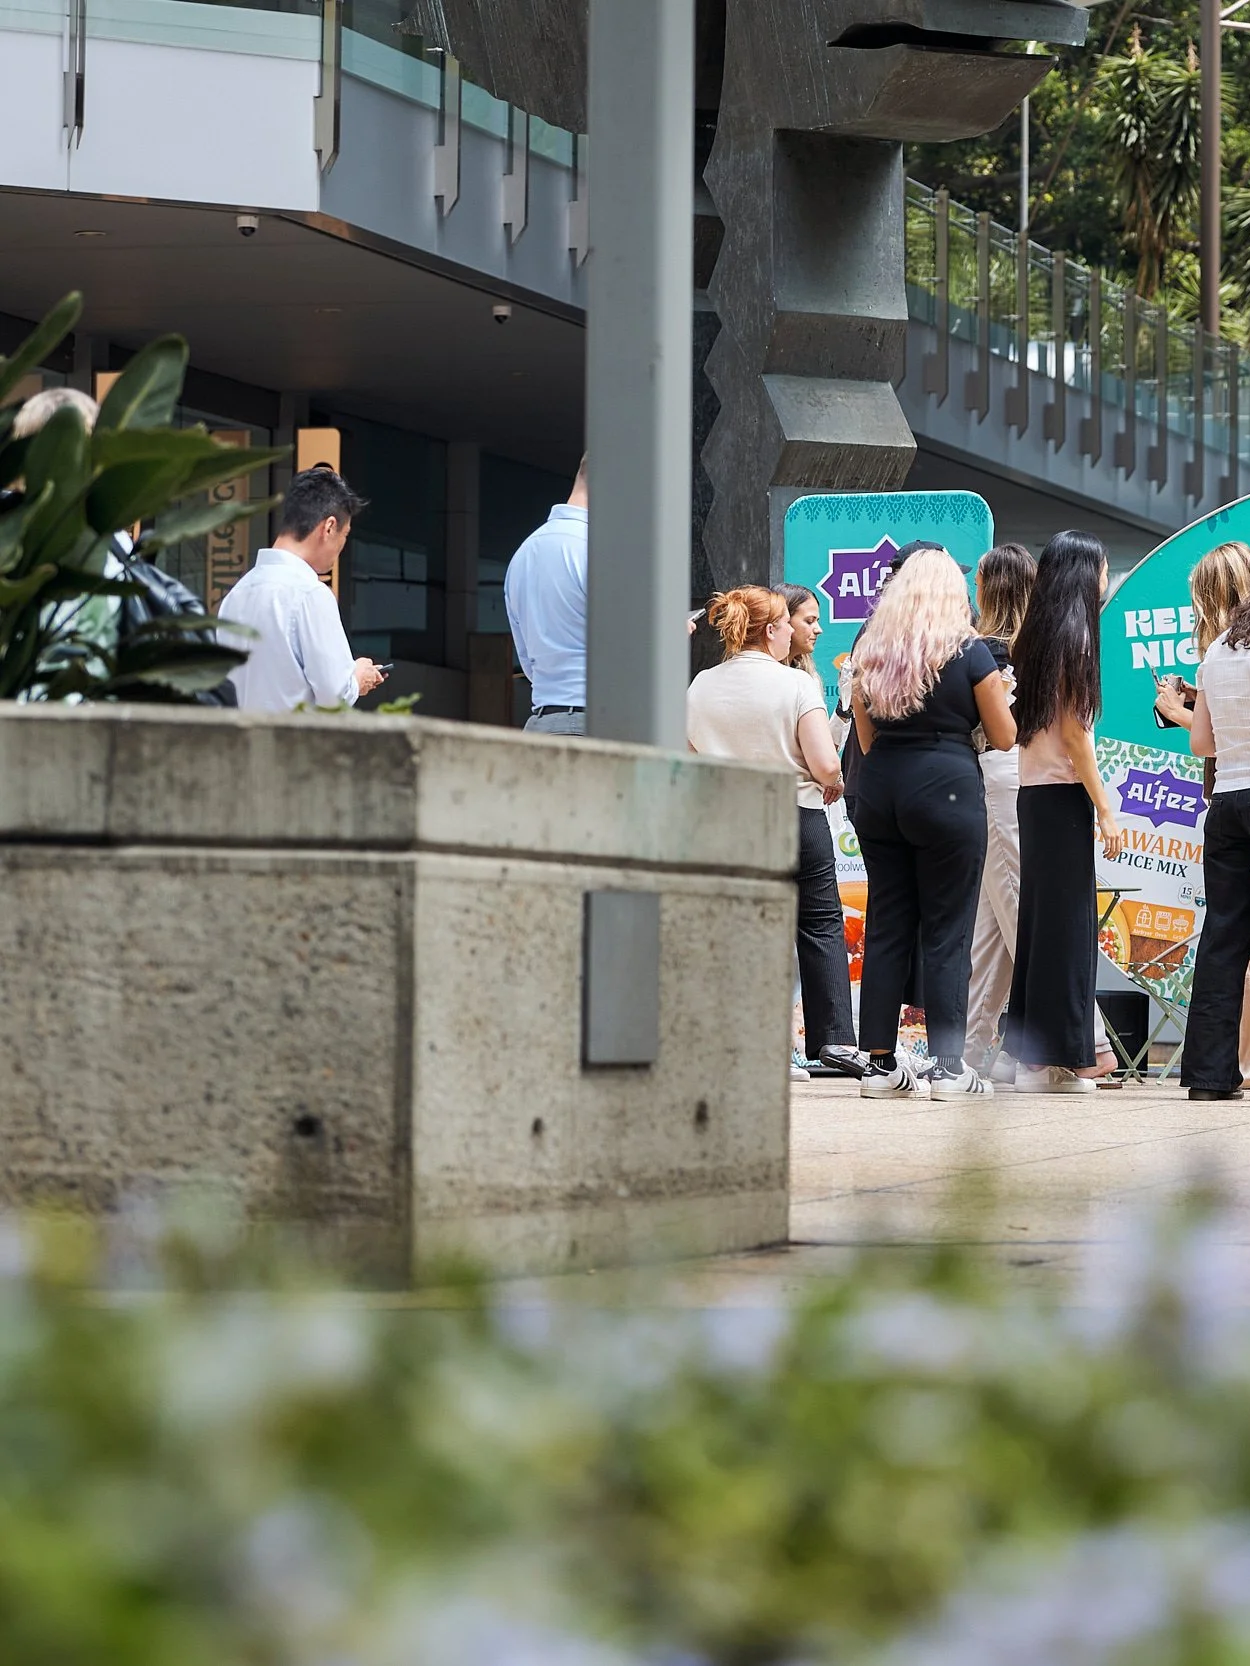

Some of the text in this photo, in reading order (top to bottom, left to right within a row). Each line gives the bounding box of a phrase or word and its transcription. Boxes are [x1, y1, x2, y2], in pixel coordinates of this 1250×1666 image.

[1124, 605, 1195, 638] KEE
[1131, 637, 1200, 669] NIG
[1156, 859, 1189, 879] MIX
[1183, 887, 1192, 895] 15
